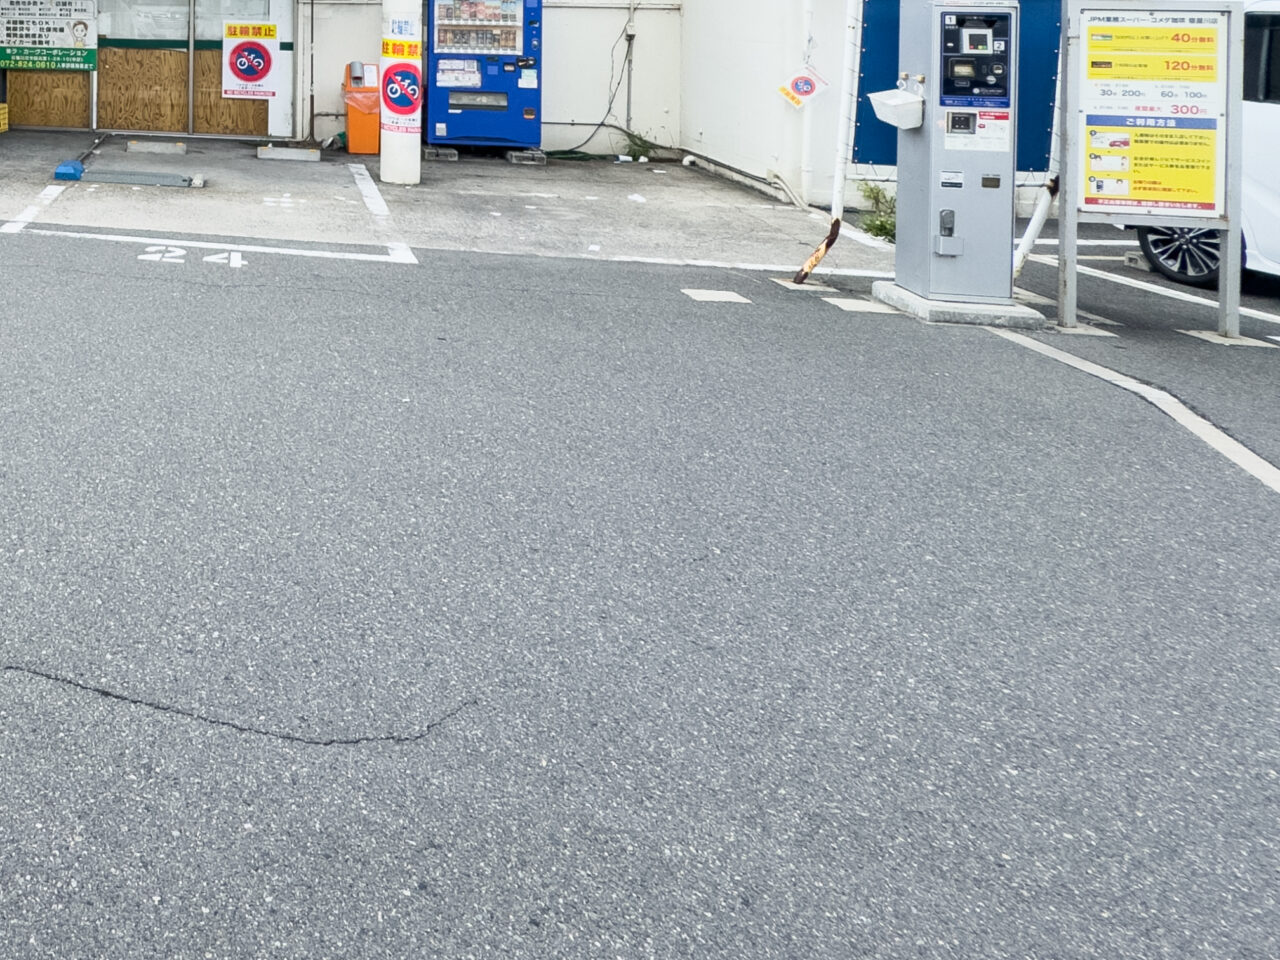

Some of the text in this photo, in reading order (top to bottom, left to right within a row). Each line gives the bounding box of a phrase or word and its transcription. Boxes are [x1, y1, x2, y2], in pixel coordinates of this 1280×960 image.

[227, 26, 275, 37] 駐輪禁止
[382, 41, 422, 56] 駐輪禁
[1125, 118, 1177, 127] ご利用方法
[137, 246, 249, 268] 24
